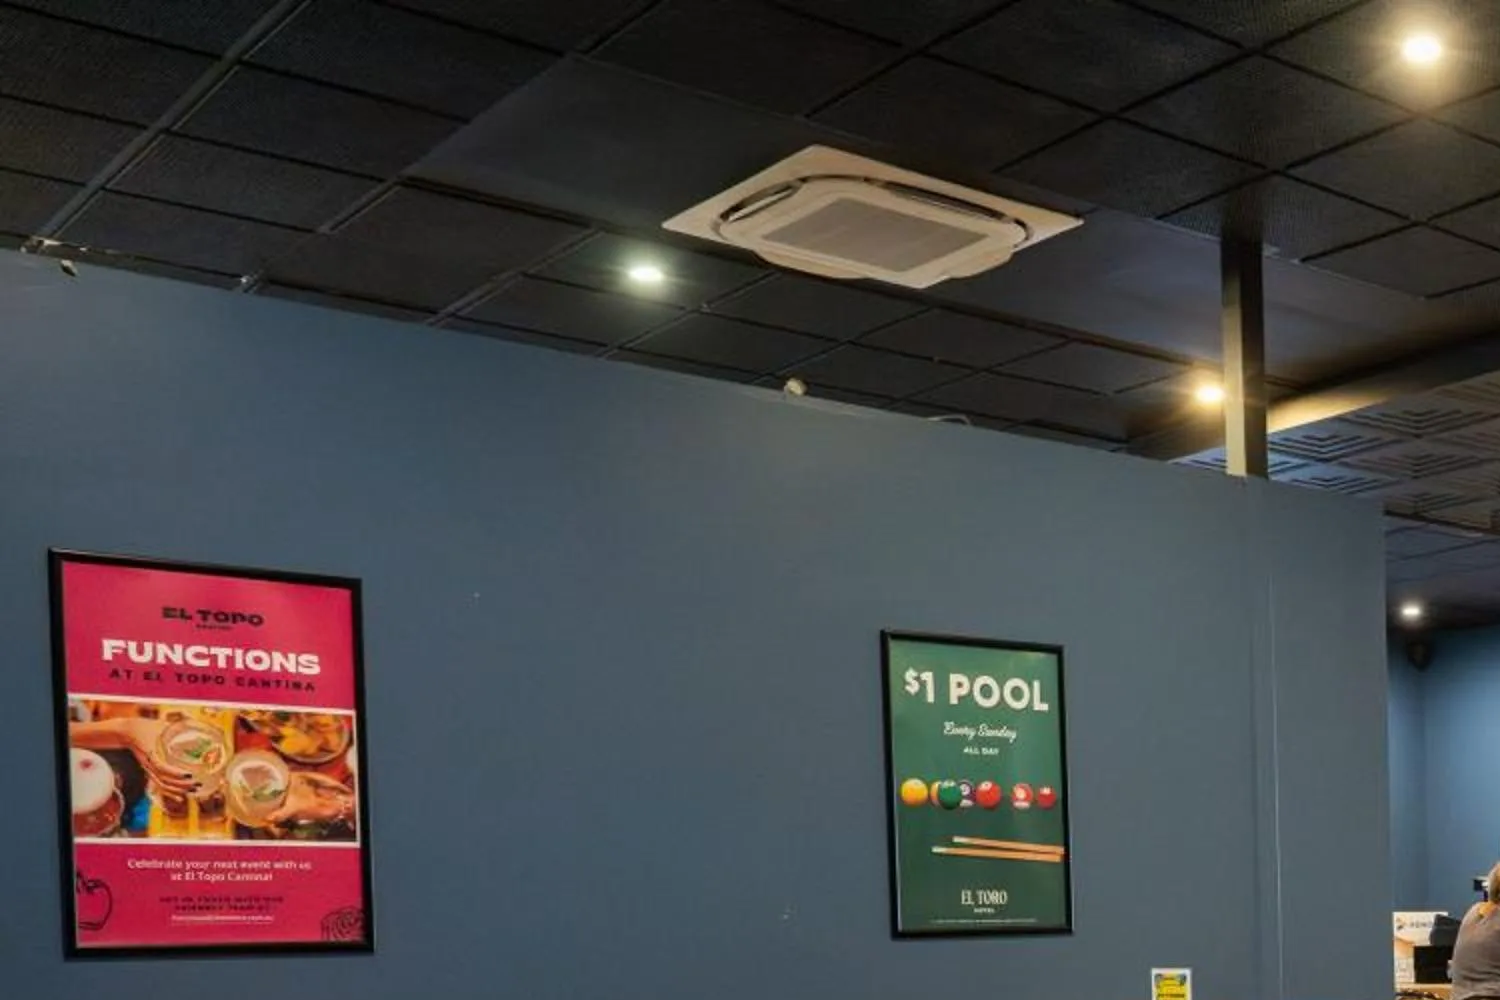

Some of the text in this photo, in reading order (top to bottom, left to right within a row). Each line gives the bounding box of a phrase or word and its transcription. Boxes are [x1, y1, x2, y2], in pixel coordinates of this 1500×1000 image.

[162, 606, 192, 621] EL
[196, 609, 264, 627] TOPO
[102, 638, 321, 675] FUNCTIONS
[109, 669, 315, 692] AT EL TOPO CANTINA
[904, 667, 1049, 711] $1 POOL
[943, 721, 1017, 744] Every Sunday
[963, 746, 999, 756] ALL DAY
[127, 859, 183, 869] Celebrate
[185, 860, 210, 871] your
[240, 860, 271, 869] event
[273, 860, 297, 869] with
[198, 871, 225, 884] Topo
[961, 889, 1008, 905] EL TORO
